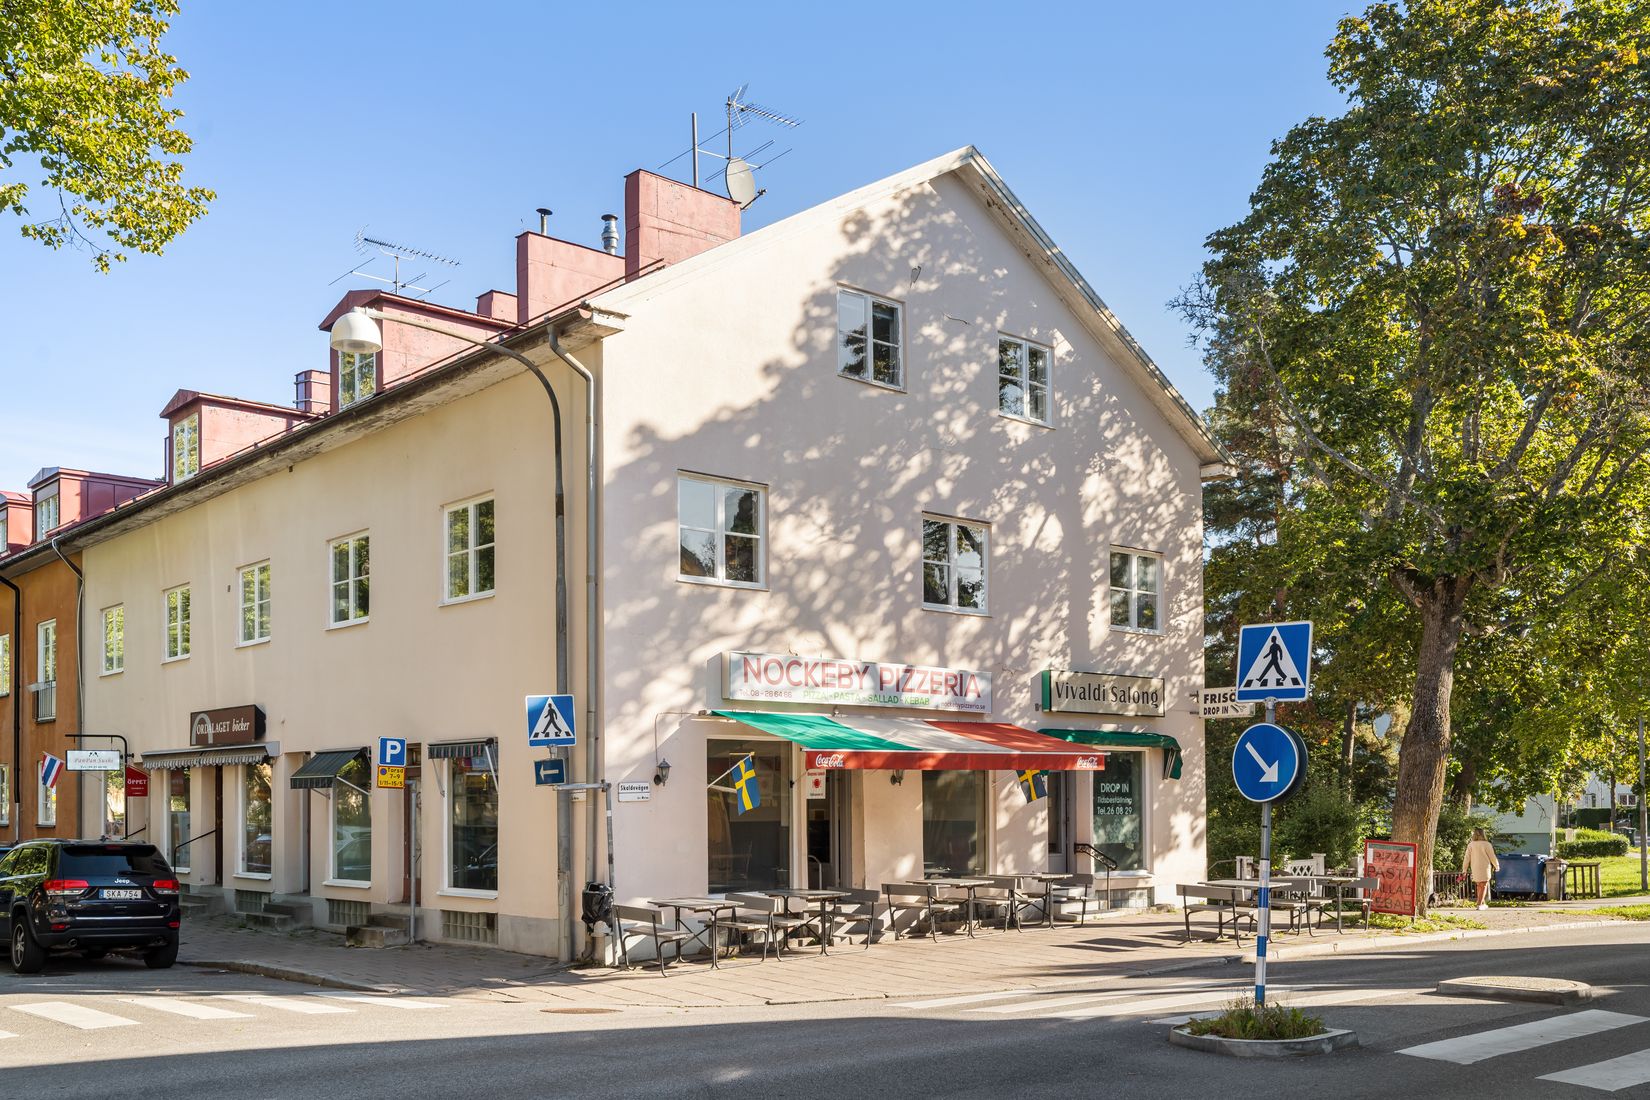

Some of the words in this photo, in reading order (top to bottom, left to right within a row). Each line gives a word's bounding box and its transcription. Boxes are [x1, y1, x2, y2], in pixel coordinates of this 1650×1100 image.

[743, 656, 869, 690] NOCKEBY
[879, 666, 981, 698] PIZZERIA
[803, 690, 827, 700] PIZZA
[834, 691, 860, 702] PASTA
[868, 694, 899, 704] SALLAD
[904, 697, 930, 705] KEBAB
[1055, 682, 1106, 702] Vivaldi
[1110, 686, 1159, 708] Salong
[1203, 689, 1236, 704] FRISÖ
[1203, 707, 1220, 715] DROP
[1221, 706, 1229, 714] IN
[231, 717, 250, 732] böcker
[386, 740, 402, 763] P
[1100, 783, 1121, 793] DROP
[1121, 783, 1130, 793] IN
[1097, 796, 1133, 805] Tidsbeställning
[1115, 806, 1124, 815] 08
[1125, 806, 1133, 815] 29
[1375, 852, 1409, 864] PIZZA
[1367, 865, 1413, 880] PASTA
[106, 890, 121, 898] SKA
[124, 890, 139, 898] 754
[1375, 883, 1413, 896] ALLAD
[1375, 897, 1412, 911] EBAB
